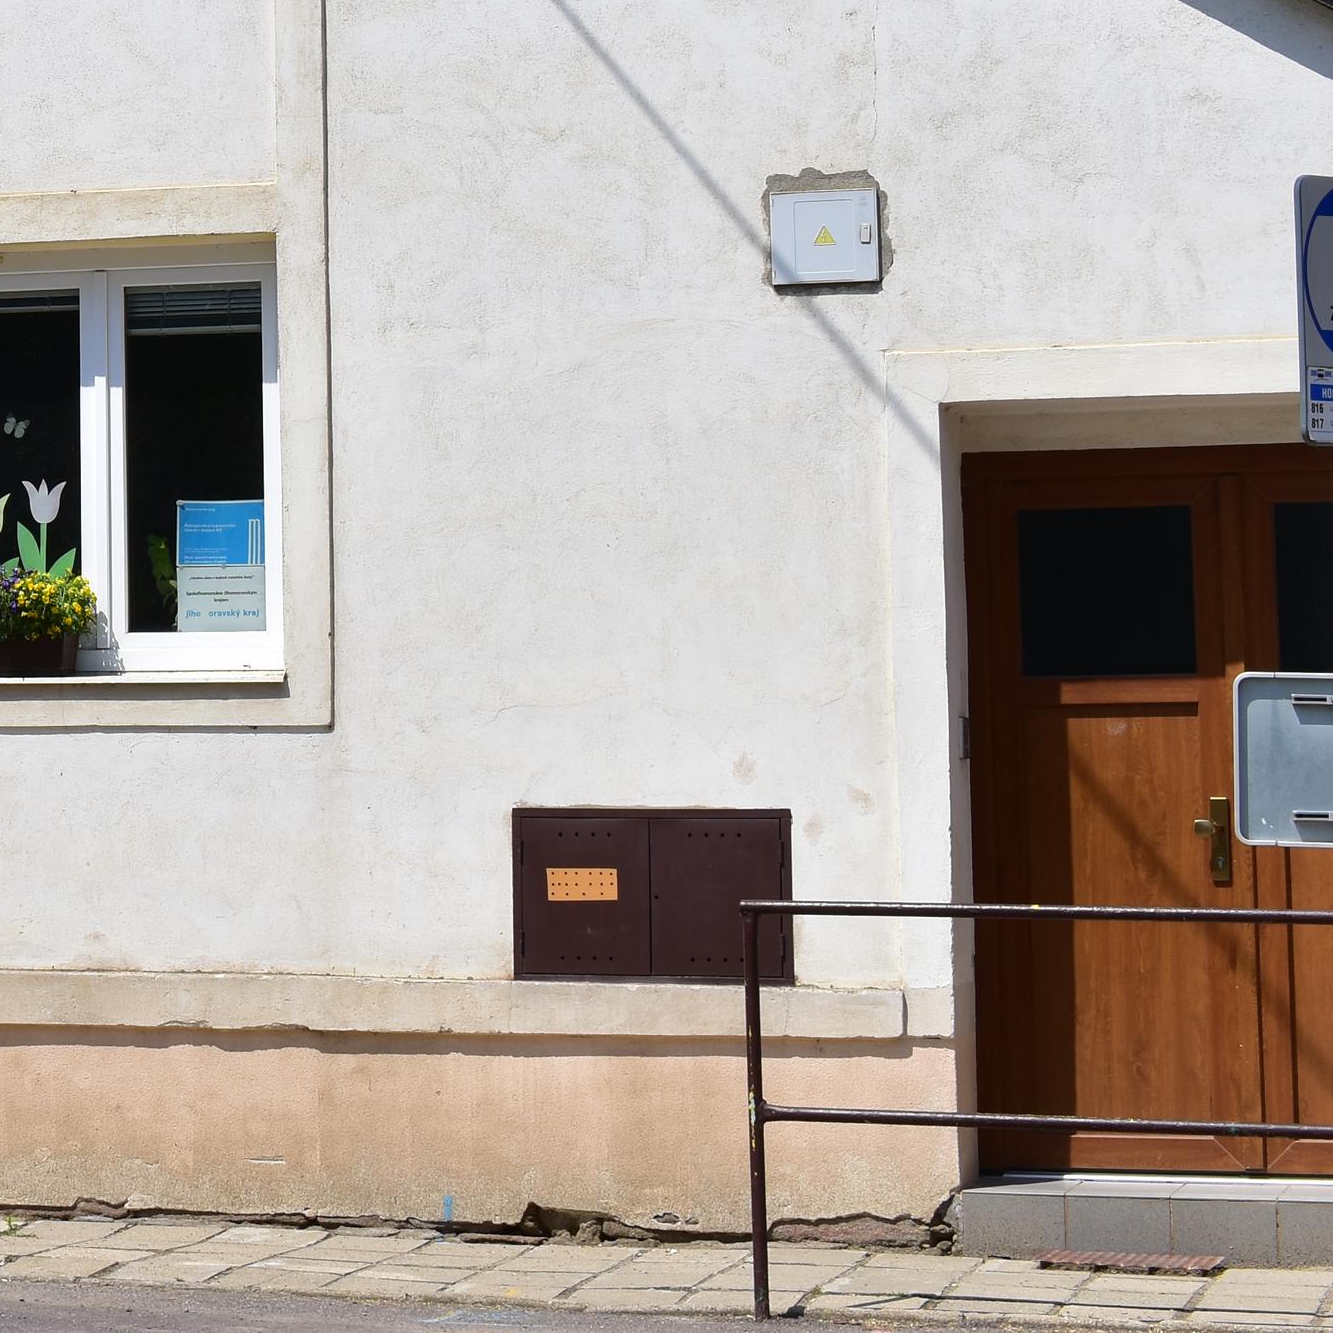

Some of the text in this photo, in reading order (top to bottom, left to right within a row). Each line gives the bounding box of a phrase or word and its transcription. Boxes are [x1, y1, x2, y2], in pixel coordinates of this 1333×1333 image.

[1322, 387, 1333, 399] HO
[1311, 402, 1324, 414] 816
[1311, 418, 1324, 429] 817
[243, 608, 260, 618] kraj
